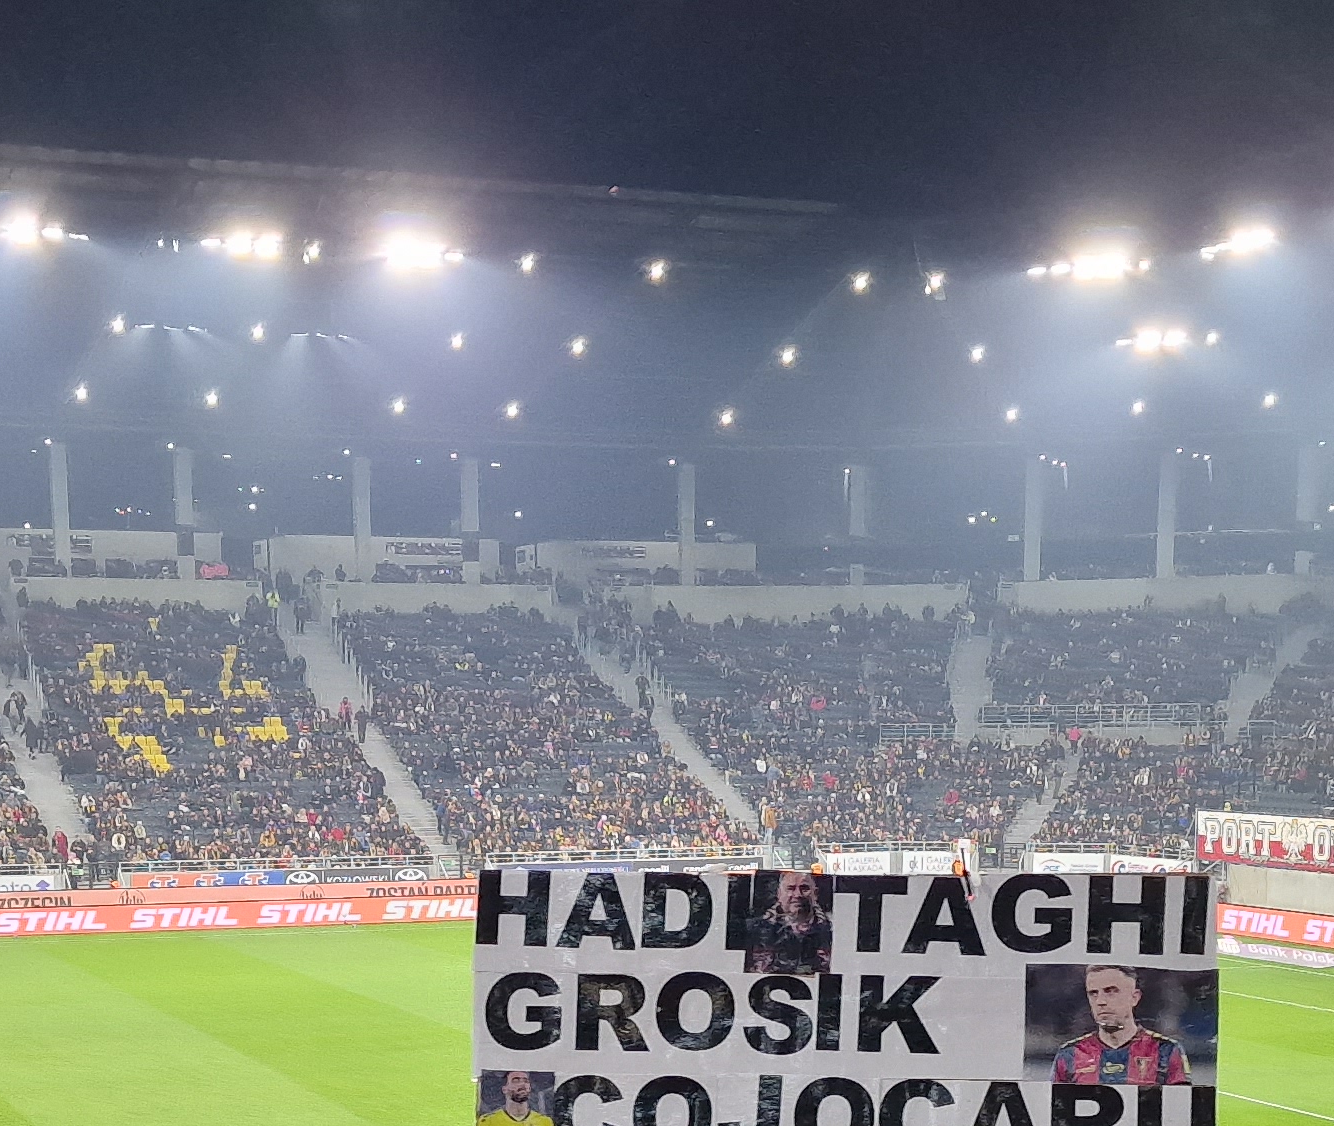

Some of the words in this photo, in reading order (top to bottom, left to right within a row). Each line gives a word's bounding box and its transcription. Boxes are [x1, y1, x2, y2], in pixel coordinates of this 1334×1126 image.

[1204, 817, 1276, 856] PORT
[130, 906, 238, 930] STIHL
[258, 902, 361, 924] STIHL
[476, 869, 756, 952] HADI
[833, 873, 1208, 957] TAGHI
[1221, 909, 1289, 938] STIHL
[1248, 943, 1291, 960] Bank
[485, 970, 941, 1055] GROSIK
